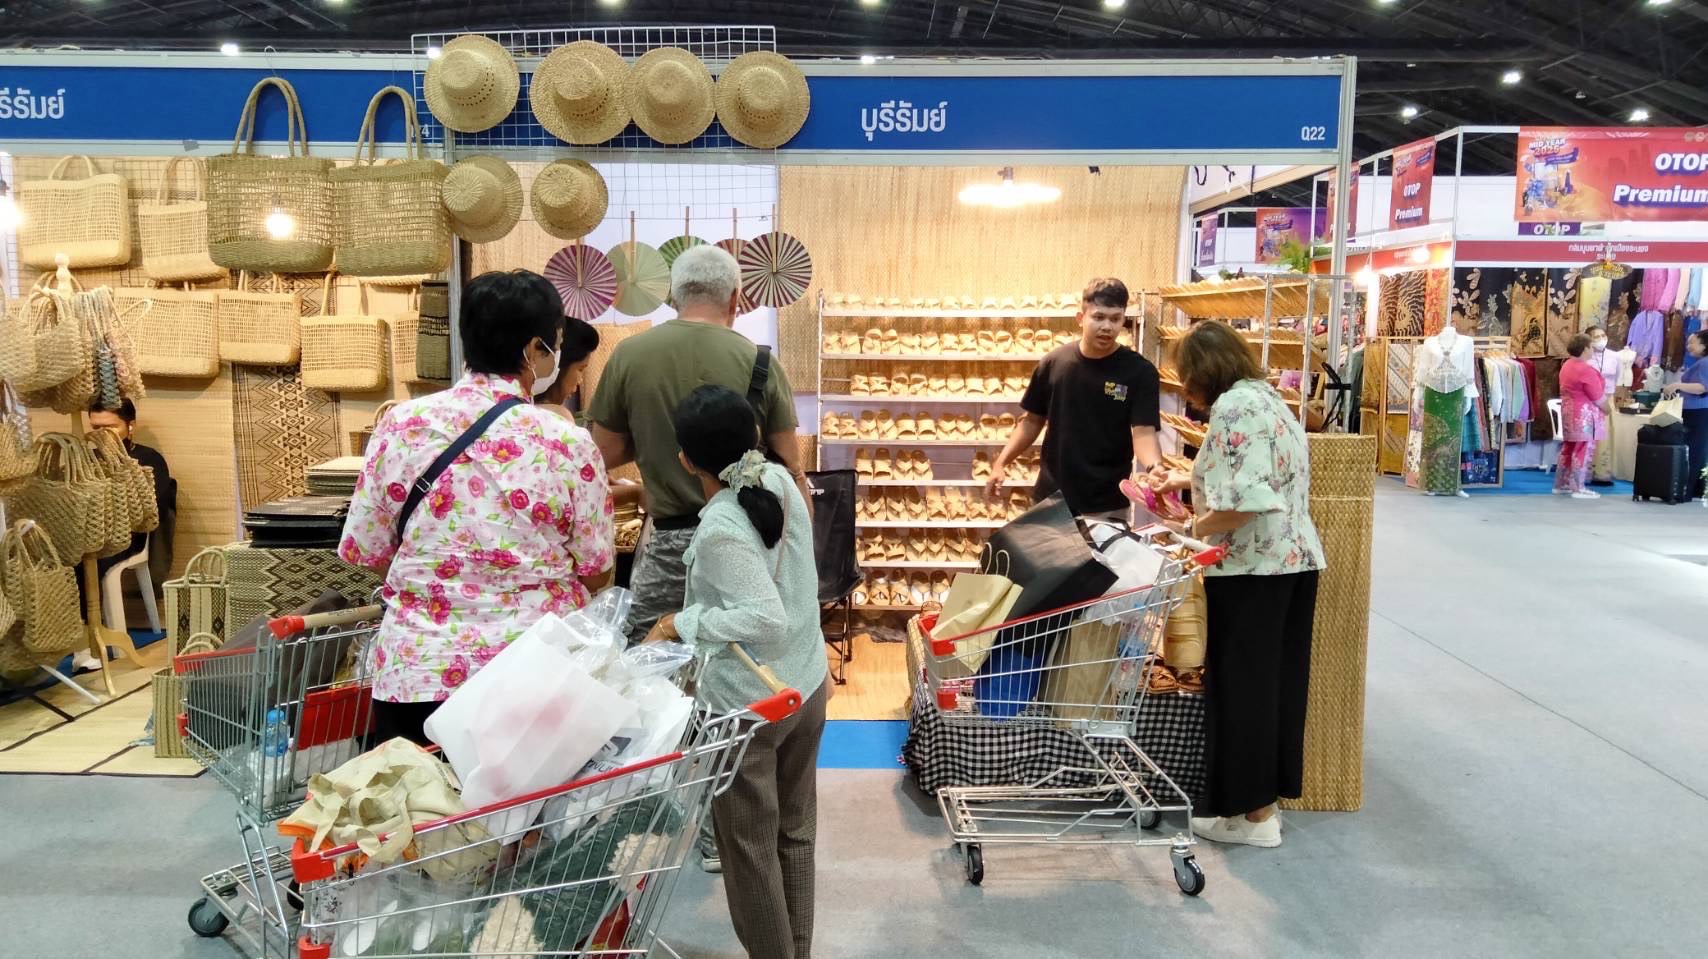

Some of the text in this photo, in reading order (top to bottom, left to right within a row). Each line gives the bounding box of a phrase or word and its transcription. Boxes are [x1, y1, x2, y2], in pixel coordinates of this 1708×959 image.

[861, 100, 948, 142] บุรีรัมย์
[1301, 126, 1326, 141] Q22
[1403, 183, 1421, 197] OTOP
[1612, 184, 1708, 203] Premium
[1395, 206, 1423, 220] Premium
